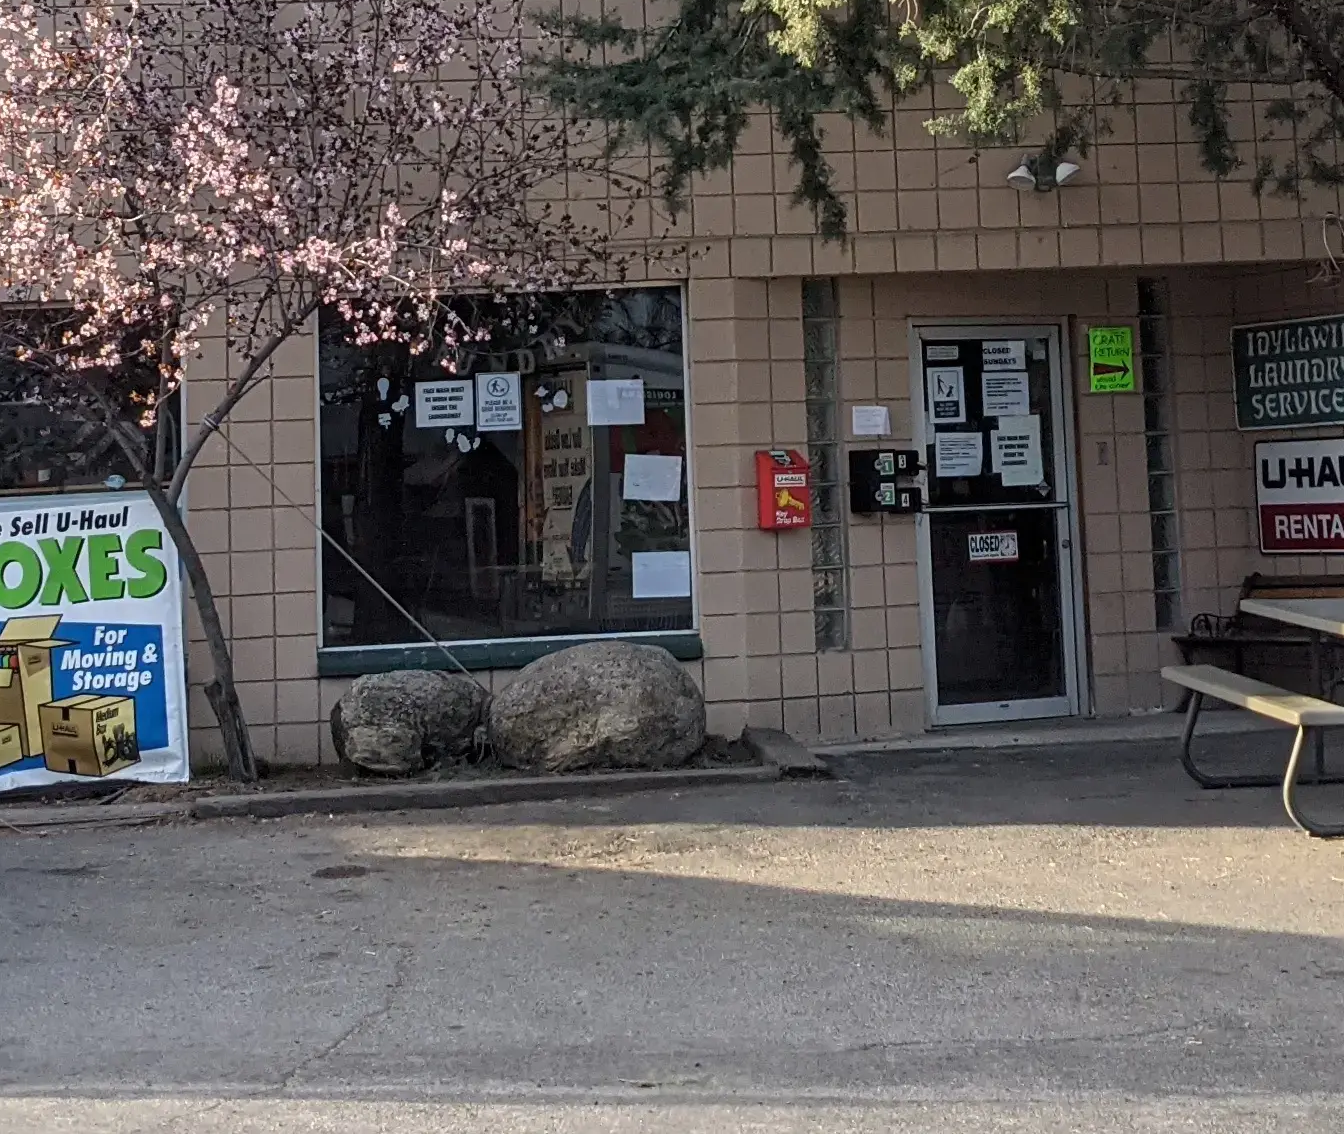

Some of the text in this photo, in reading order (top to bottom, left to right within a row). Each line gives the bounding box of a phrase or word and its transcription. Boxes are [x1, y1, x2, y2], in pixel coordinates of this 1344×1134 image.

[983, 347, 1011, 355] CLOSED
[983, 357, 1017, 365] SUNDAYS
[884, 462, 890, 471] 1
[885, 491, 891, 501] 2
[903, 494, 908, 505] 4
[10, 513, 49, 537] Sell
[56, 506, 129, 533] U-Haul
[970, 535, 1000, 553] CLOSED
[94, 626, 127, 646] For
[61, 646, 138, 671] Moving
[141, 642, 158, 664] &
[72, 670, 153, 692] Storage
